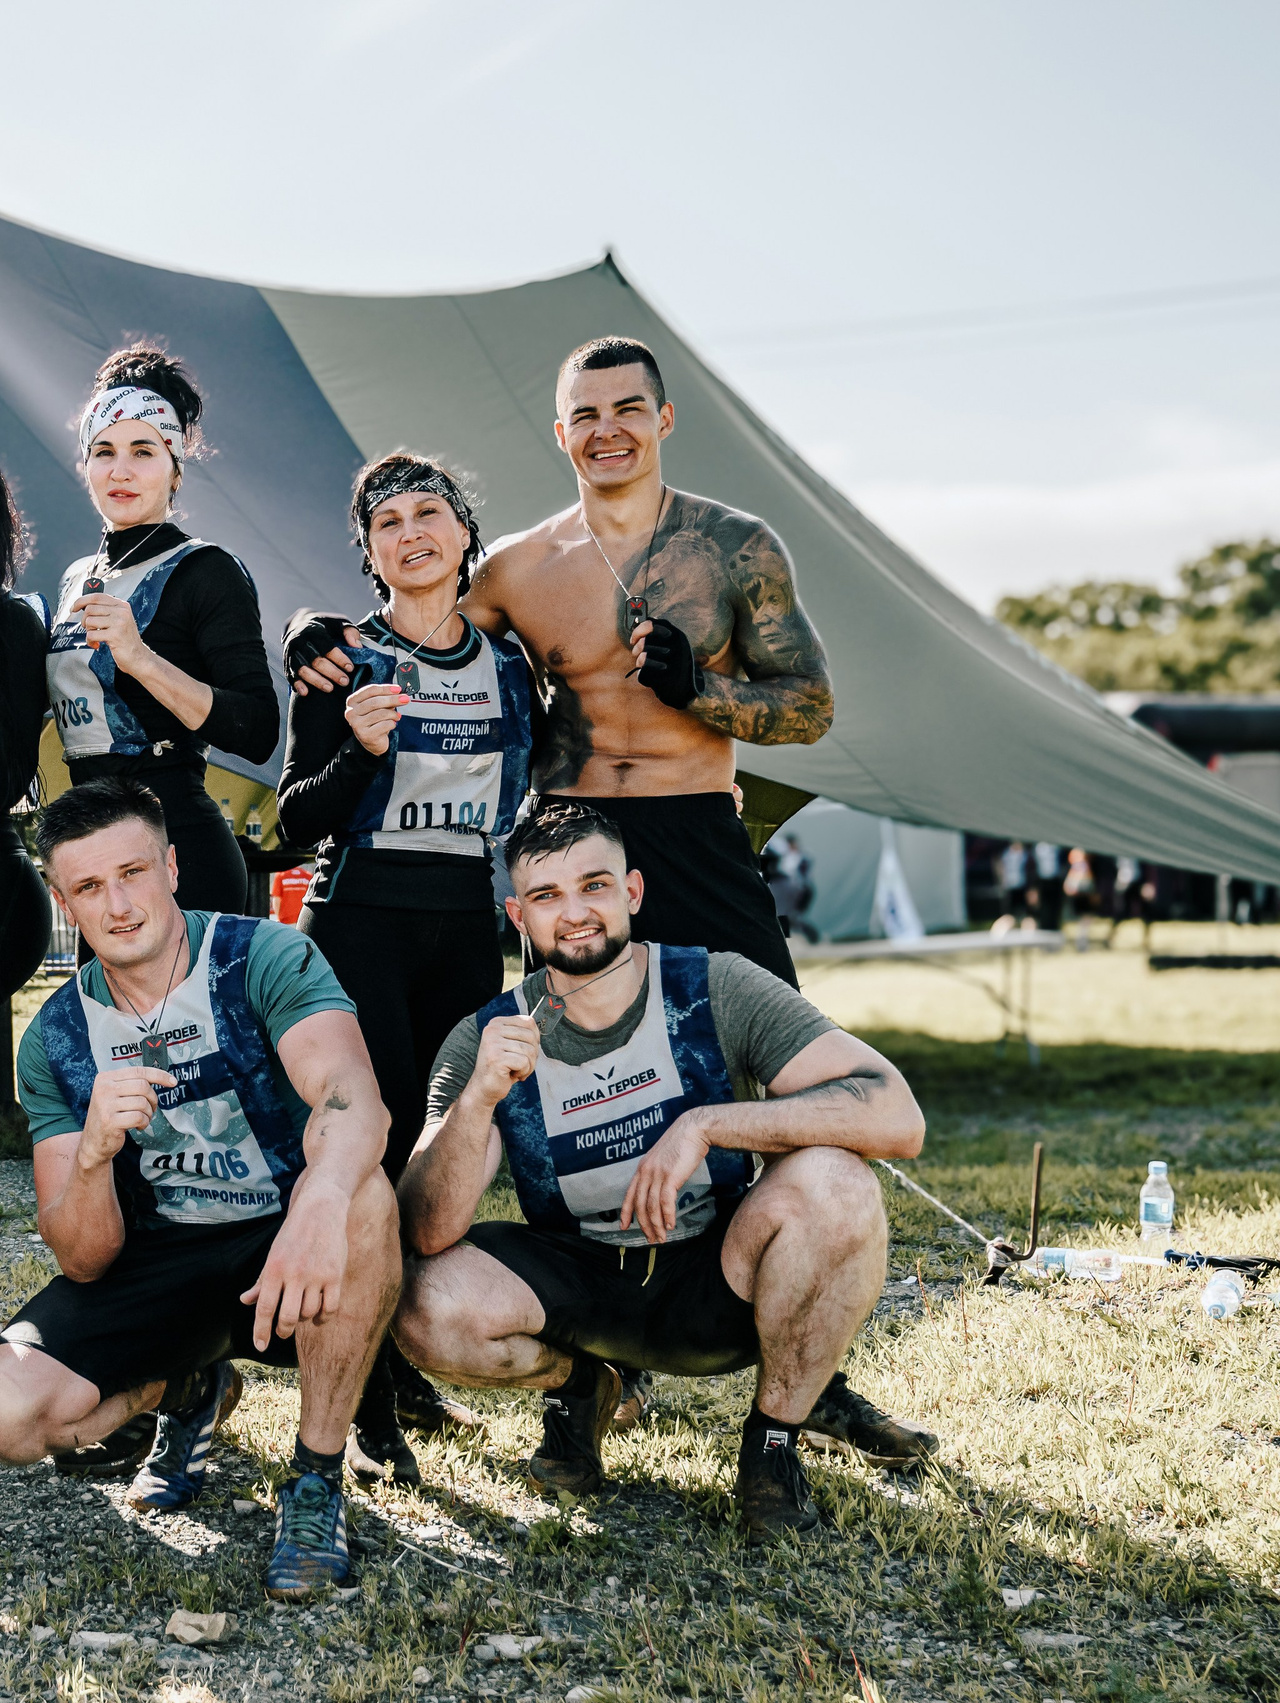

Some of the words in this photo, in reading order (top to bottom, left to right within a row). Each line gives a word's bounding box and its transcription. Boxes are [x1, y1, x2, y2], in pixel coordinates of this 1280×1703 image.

[100, 387, 137, 418] TORERO
[132, 408, 158, 420] TORE
[452, 691, 489, 703] ГЕРОЕВ
[421, 720, 490, 736] КОМАНДНЫЙ
[442, 738, 475, 751] СТАРТ
[399, 802, 486, 831] 01104
[111, 1041, 142, 1056] ГОНК
[160, 1024, 198, 1043] РОЕВ
[562, 1090, 605, 1111] ГОНКА
[608, 1068, 657, 1097] ГЕРОЕВ
[576, 1103, 664, 1150] КОМАНДНЫЙ
[605, 1135, 645, 1160] СТАРТ
[184, 1187, 274, 1206] ГАЗПРОМБАНК
